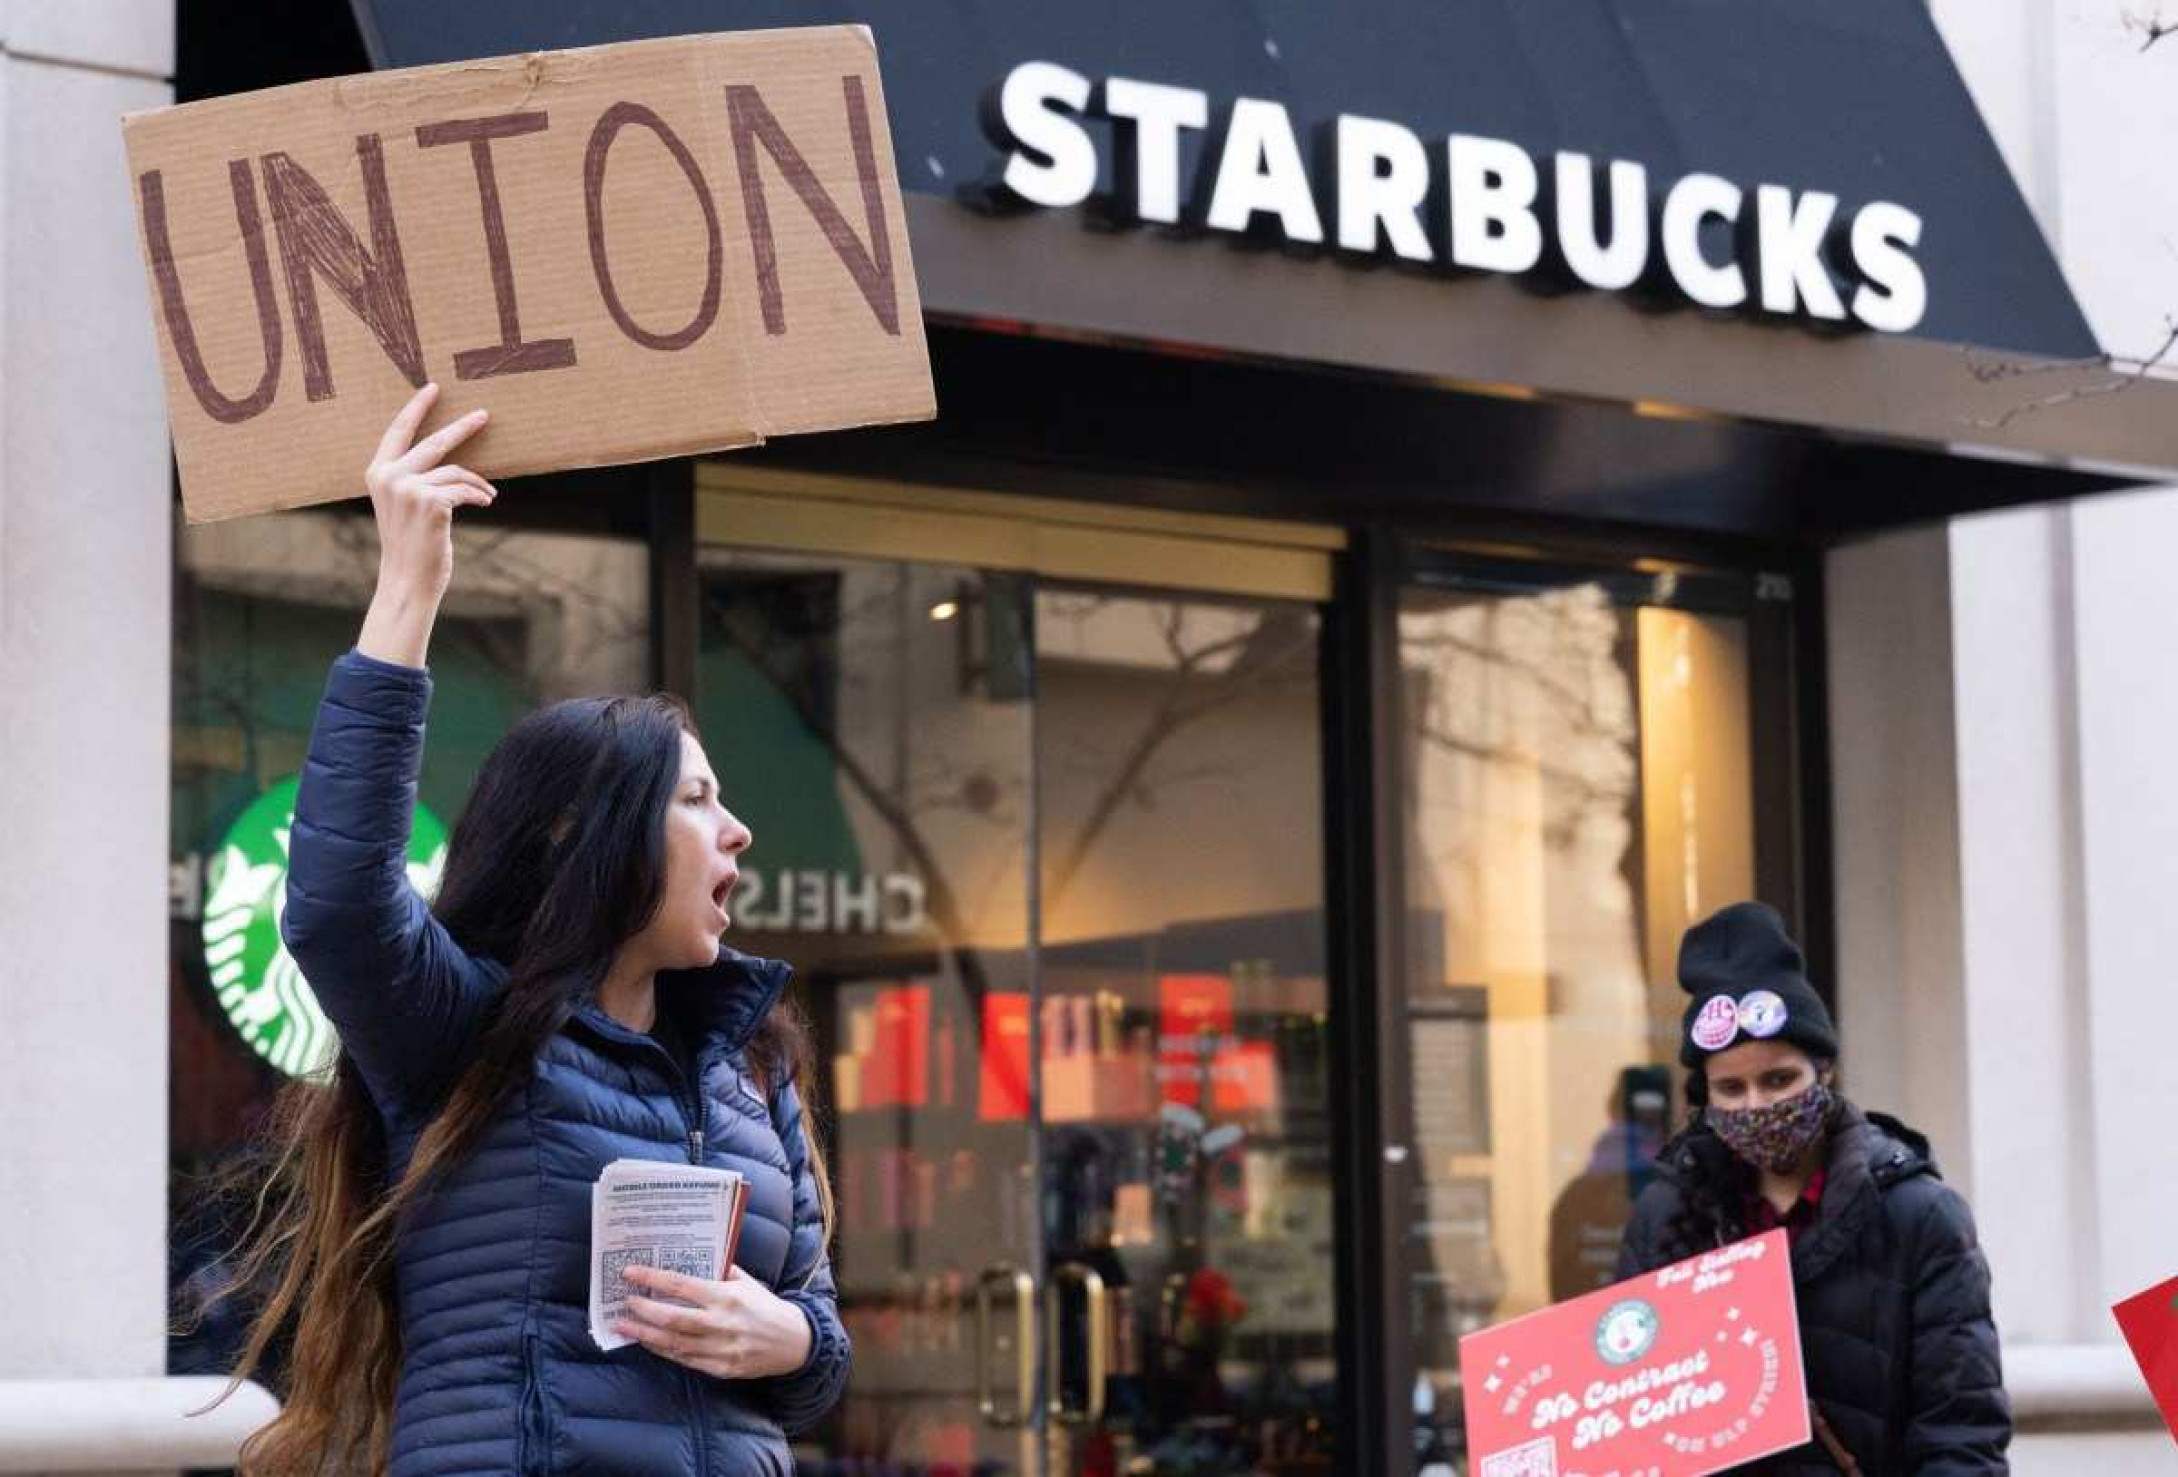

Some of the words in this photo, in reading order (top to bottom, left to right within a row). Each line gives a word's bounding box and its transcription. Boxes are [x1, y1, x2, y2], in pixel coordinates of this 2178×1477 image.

[140, 75, 901, 424] UNION
[999, 60, 1928, 333] STARBUCKS
[1531, 1392, 1580, 1429] No
[1584, 1349, 1710, 1410] Contract
[1572, 1409, 1626, 1450] No
[1630, 1379, 1726, 1429] Coffee
